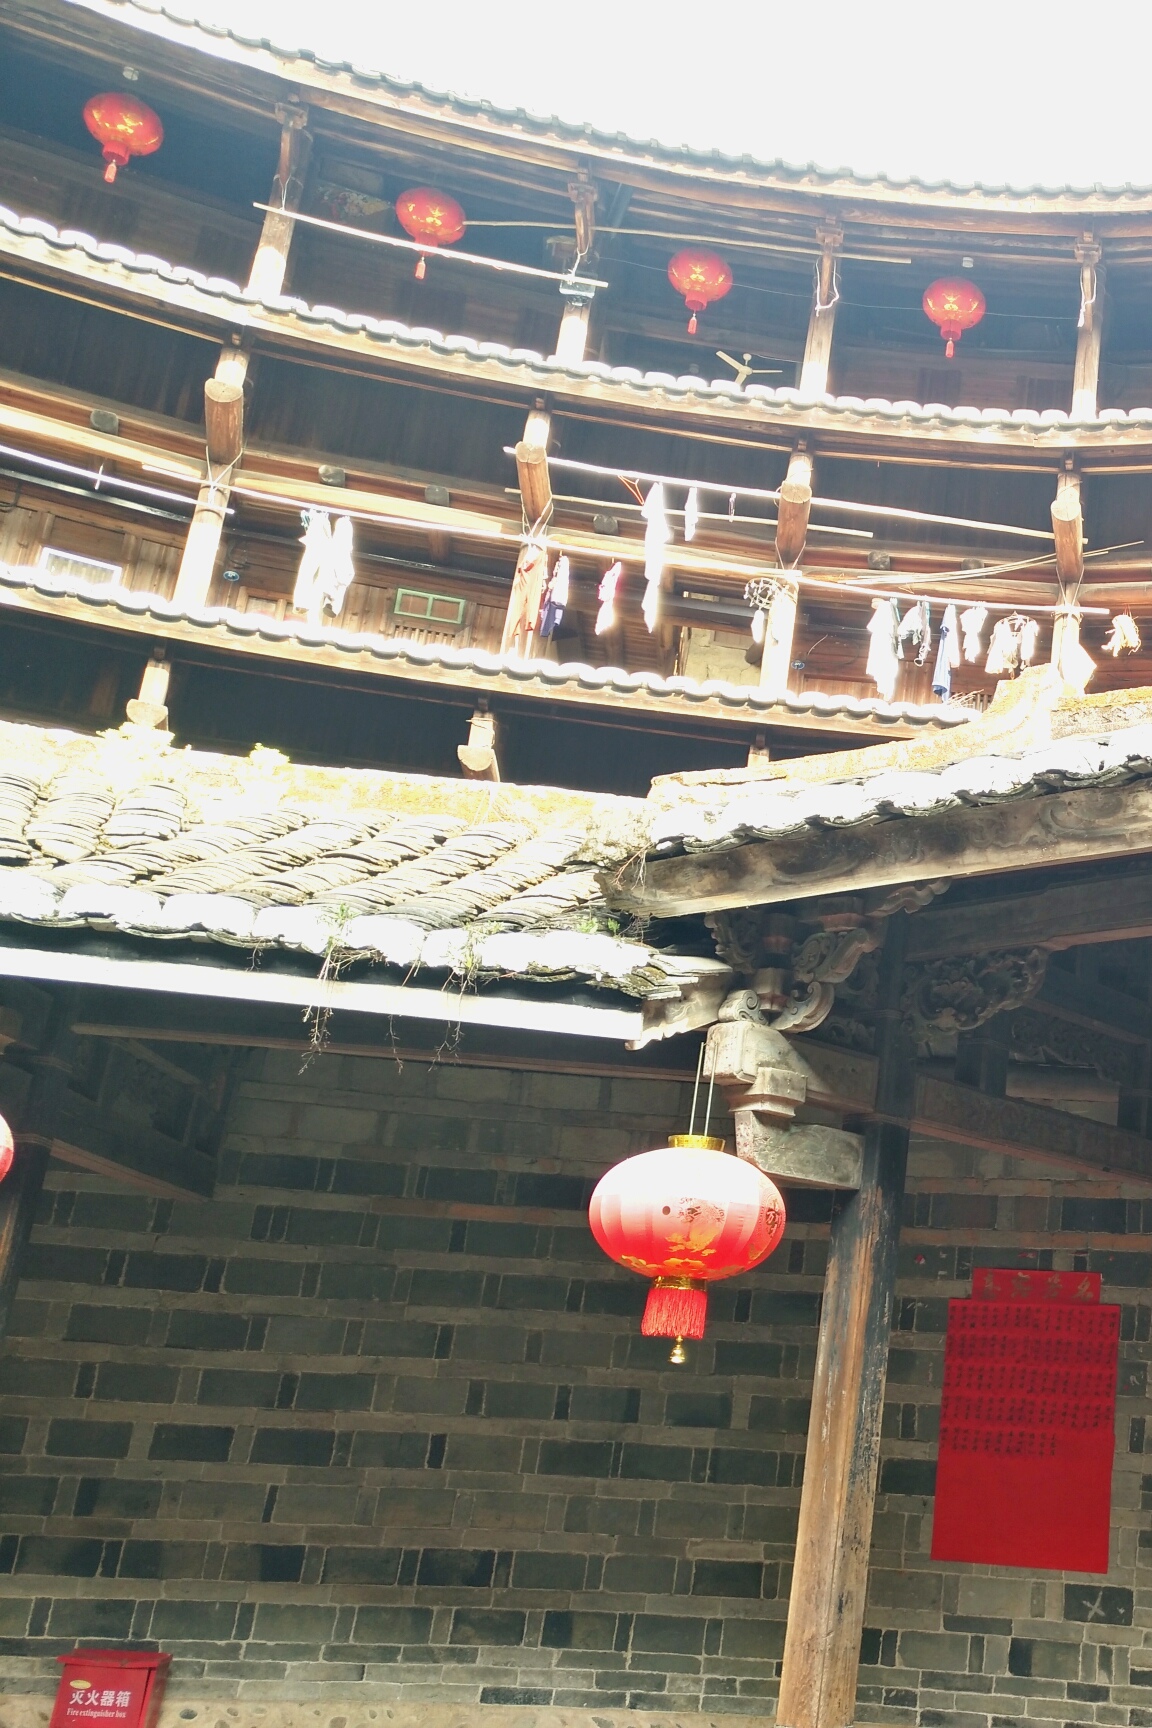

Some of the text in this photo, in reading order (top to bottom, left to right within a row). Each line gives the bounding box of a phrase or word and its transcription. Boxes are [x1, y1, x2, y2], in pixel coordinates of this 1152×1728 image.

[69, 1690, 132, 1707] 灭火器箱
[66, 1708, 127, 1718] Fire extinguisher box
